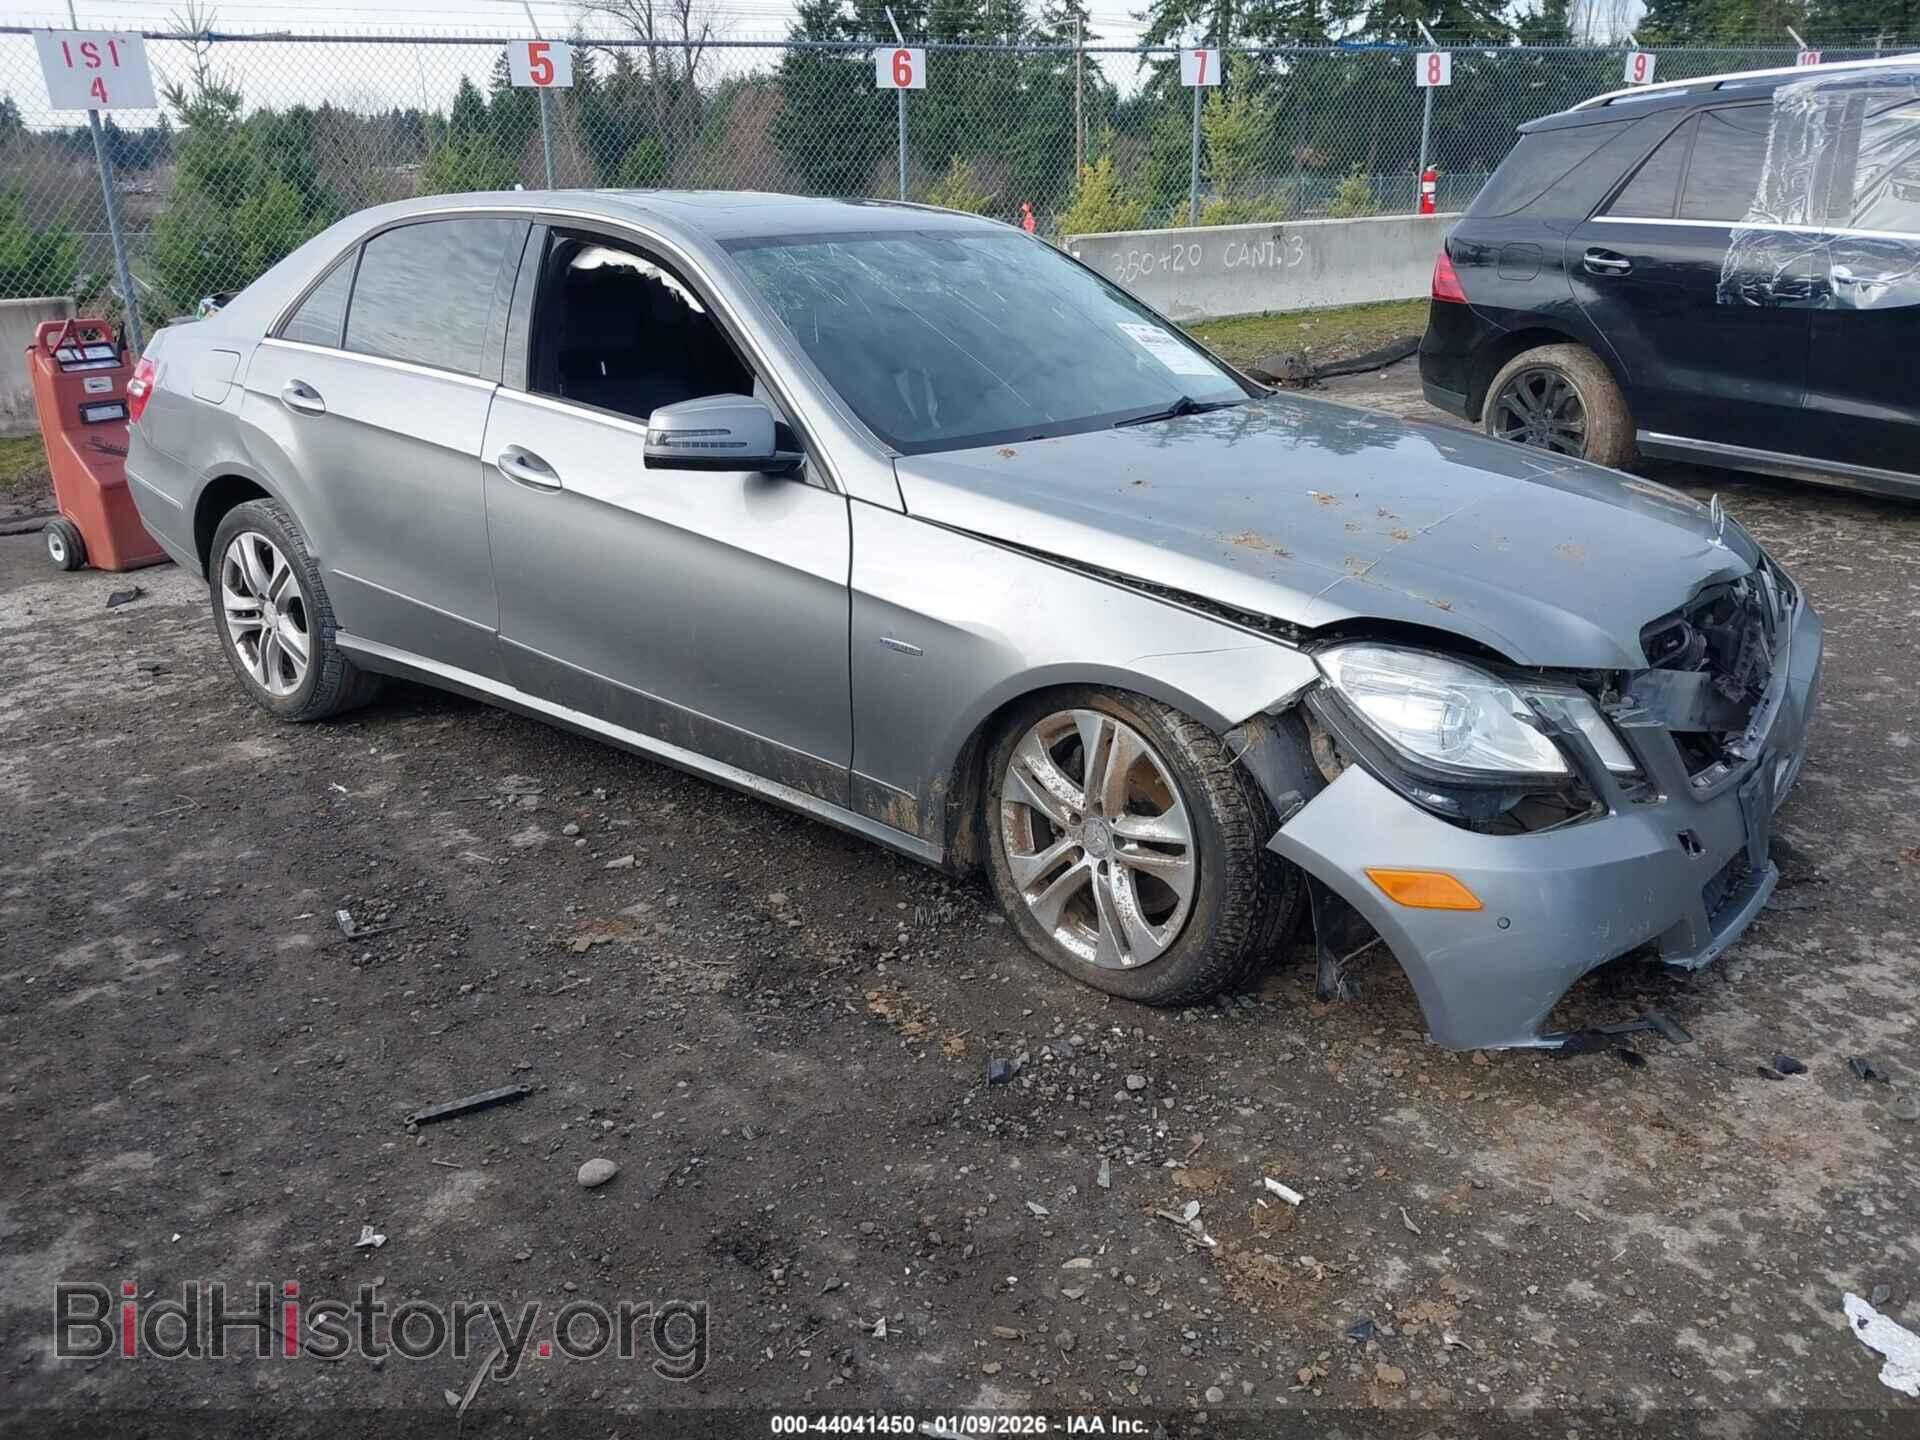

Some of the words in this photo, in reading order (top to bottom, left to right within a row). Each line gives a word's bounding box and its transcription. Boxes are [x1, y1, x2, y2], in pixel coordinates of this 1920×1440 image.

[527, 42, 554, 85] 5
[892, 49, 912, 87] 6
[1194, 51, 1207, 84] 7
[1427, 54, 1441, 84] 8
[1634, 54, 1646, 81] 9
[91, 76, 108, 103] 4
[1287, 235, 1304, 267] 3
